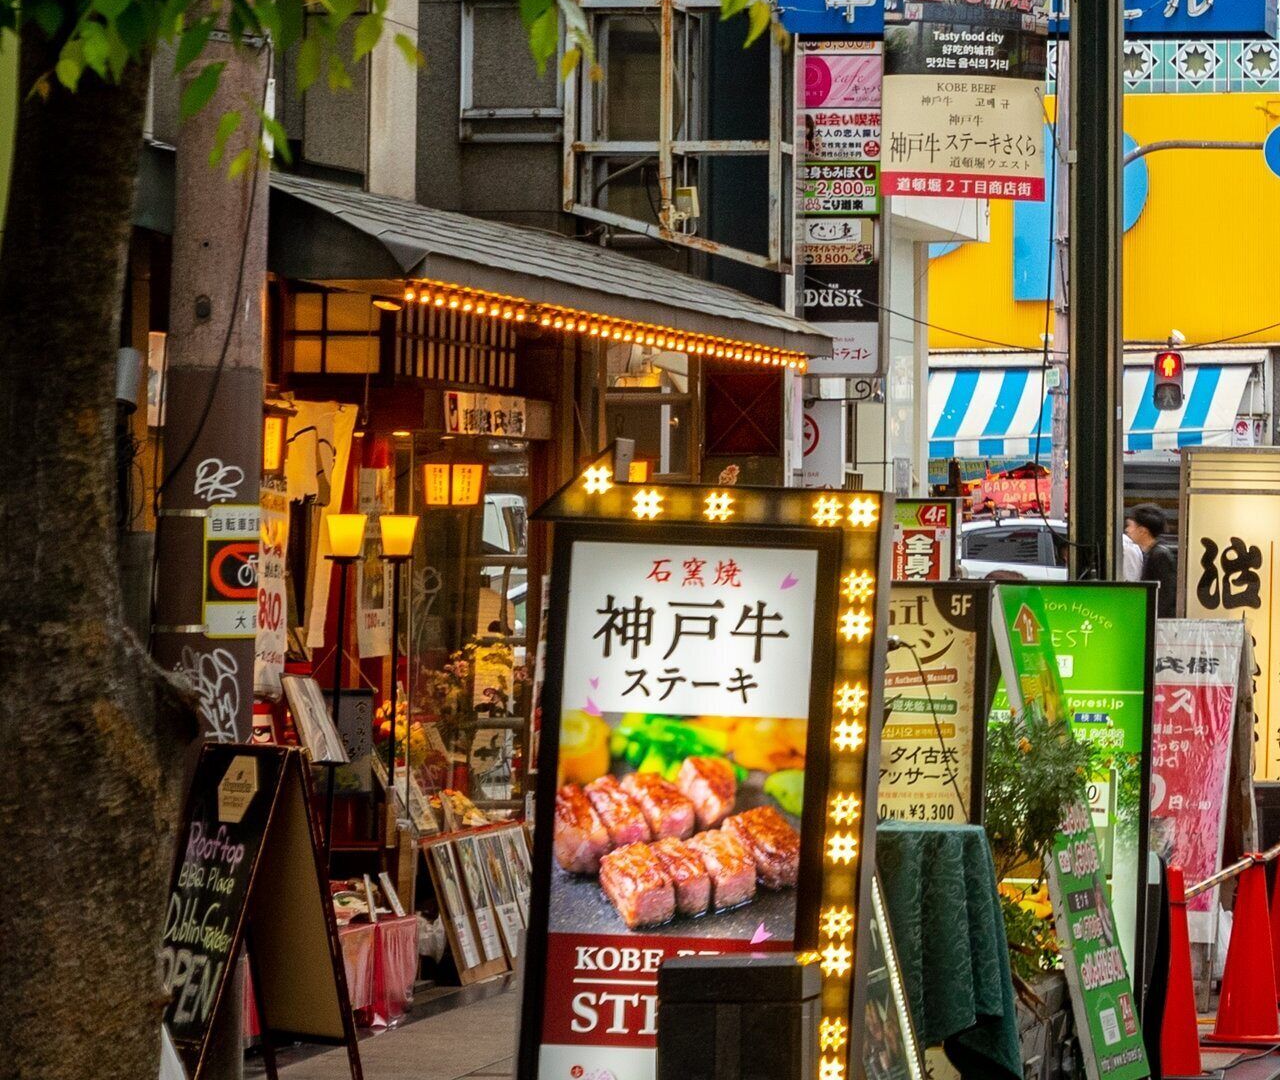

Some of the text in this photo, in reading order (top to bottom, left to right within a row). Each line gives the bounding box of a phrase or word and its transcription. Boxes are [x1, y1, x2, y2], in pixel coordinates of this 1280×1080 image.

[933, 31, 1005, 45] Tasty food city
[942, 45, 995, 57] 好吃的城市
[925, 57, 1010, 71] 맛있는 음식의 거리
[937, 83, 997, 94] KOBE BEEF
[804, 289, 853, 308] DUSK
[925, 506, 946, 522] 4F
[905, 533, 934, 580] 全身
[645, 557, 743, 589] 石窯焼
[951, 594, 972, 616] 5F
[592, 594, 791, 663] 神戸牛
[619, 667, 759, 704] ステーキ
[890, 746, 960, 766] タイ古式
[909, 801, 955, 822] ¥3,300
[573, 946, 663, 974] KOBE
